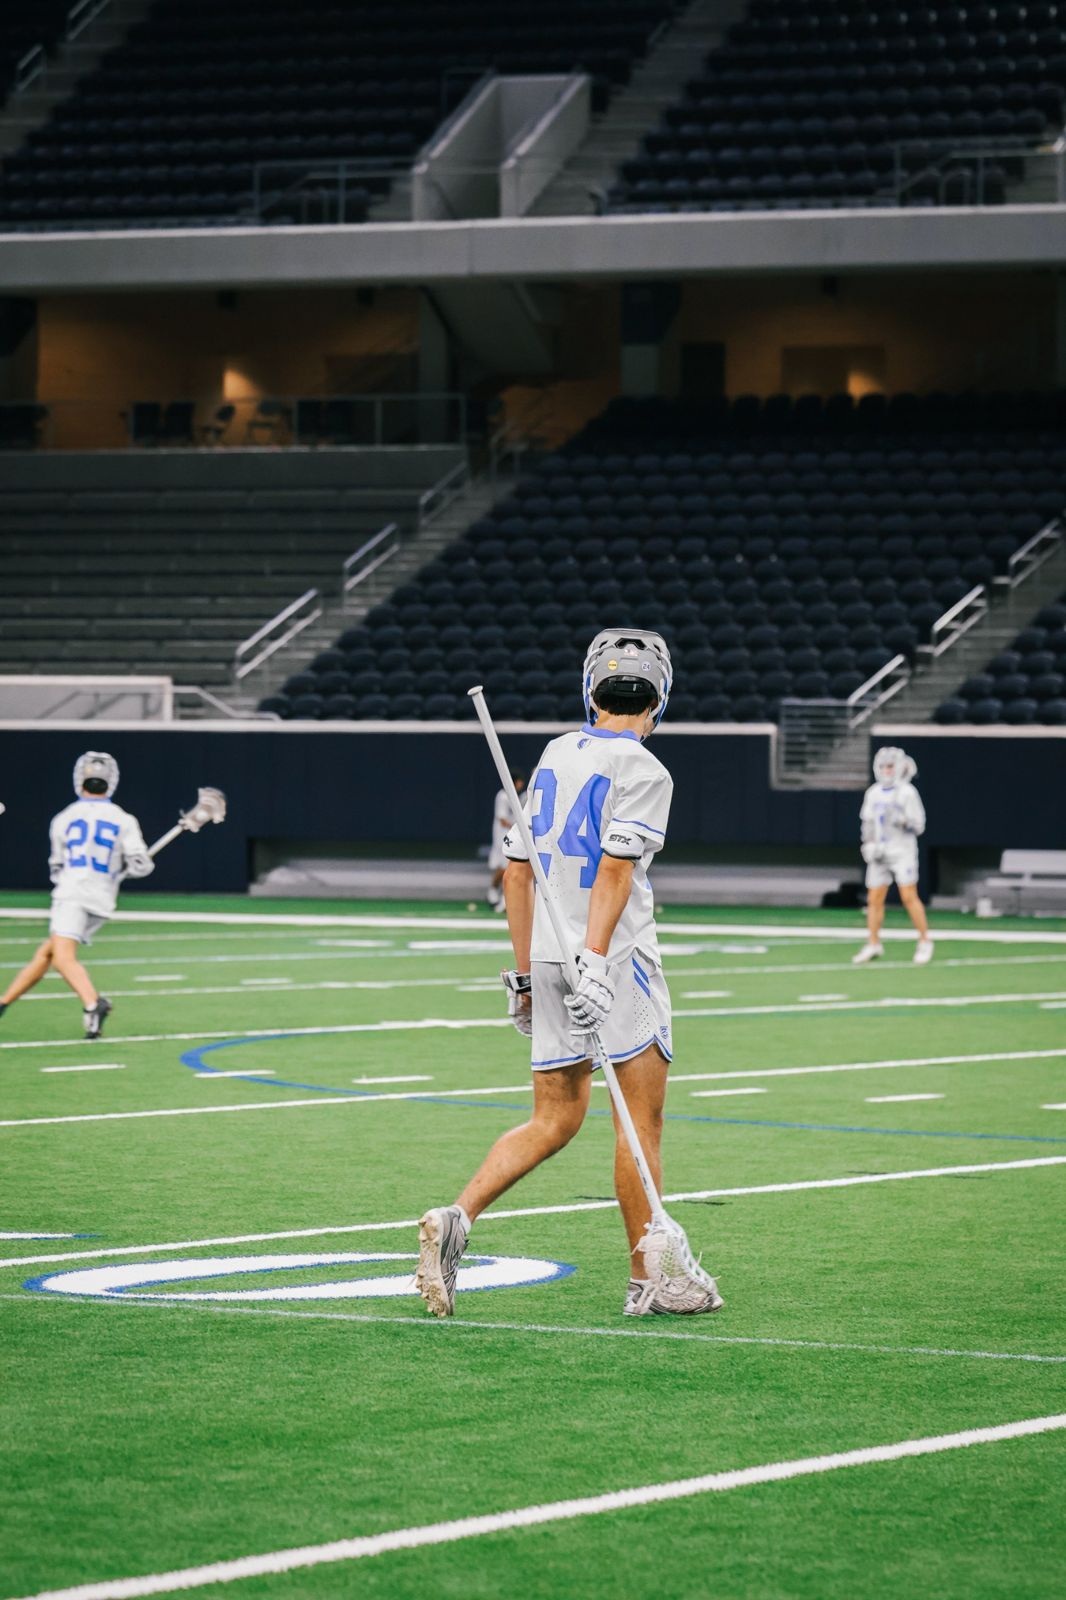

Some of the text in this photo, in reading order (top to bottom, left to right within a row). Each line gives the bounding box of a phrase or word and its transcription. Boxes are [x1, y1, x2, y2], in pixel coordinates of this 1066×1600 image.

[65, 818, 120, 873] 25
[532, 768, 611, 888] 24
[608, 834, 632, 845] STX
